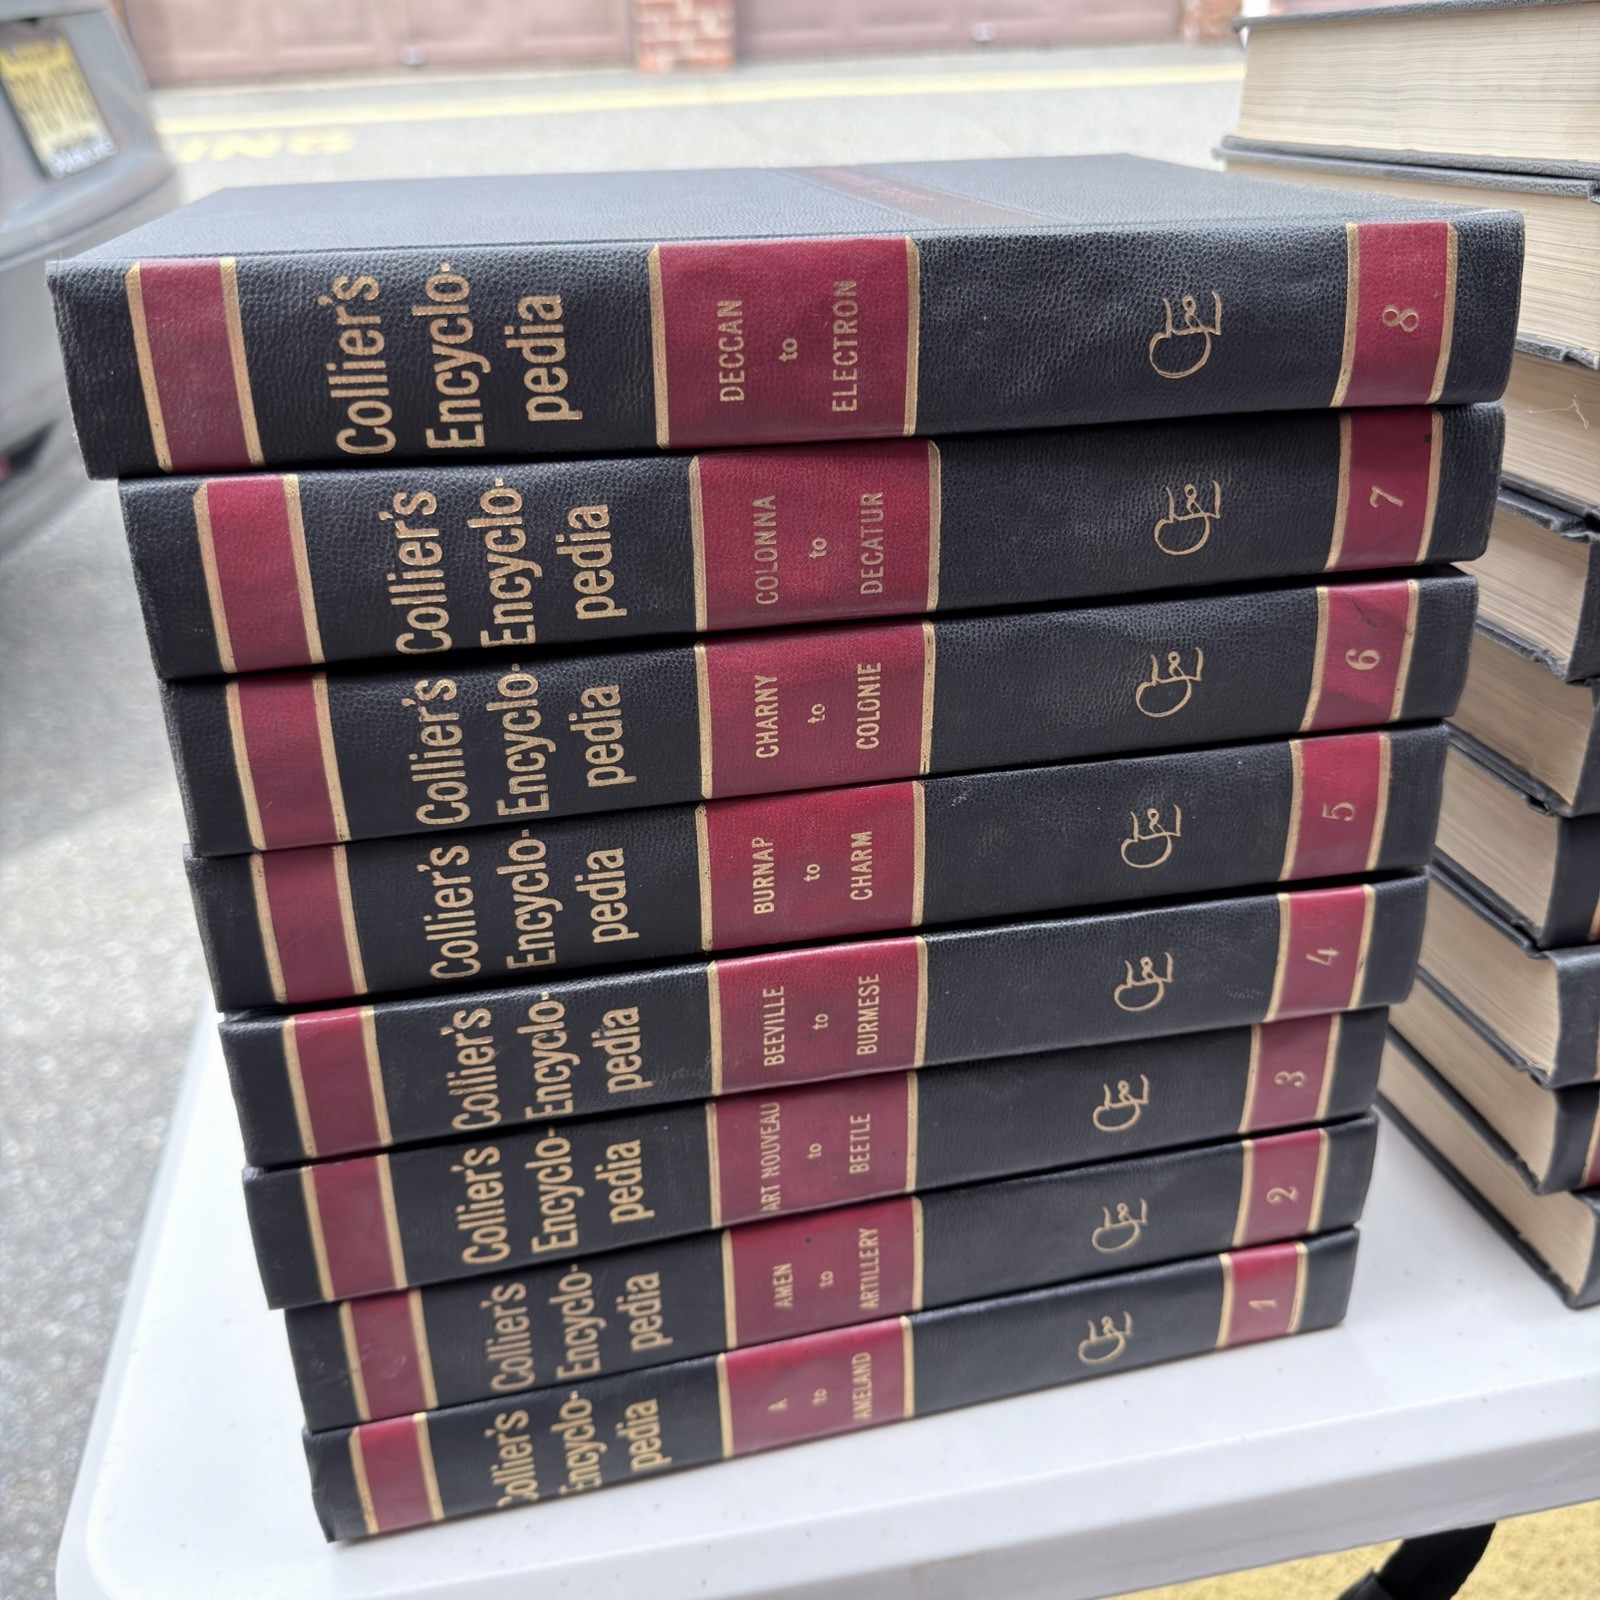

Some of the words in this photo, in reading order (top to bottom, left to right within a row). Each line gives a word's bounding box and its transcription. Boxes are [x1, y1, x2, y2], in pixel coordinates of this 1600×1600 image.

[504, 294, 584, 422] pedia
[717, 299, 746, 402] DECCAN
[778, 337, 799, 363] to
[831, 279, 858, 413] ELECTRON
[1381, 304, 1420, 333] 8
[318, 274, 397, 455] Collier's
[1369, 485, 1404, 508] 7
[378, 490, 453, 655] Collier's
[554, 503, 628, 620] pedia
[753, 494, 780, 605] COLONNA
[808, 537, 828, 560] to
[859, 491, 885, 595] DECATUR
[1344, 648, 1381, 672] 6
[568, 683, 638, 788] pedia
[753, 674, 780, 759] CHARNY
[807, 702, 827, 725] to
[855, 661, 882, 751] COLONIE
[401, 678, 472, 826] Collier's
[1321, 801, 1356, 823] 5
[573, 846, 640, 944] pedia
[751, 836, 776, 916] BURNAP
[803, 862, 822, 884] to
[849, 830, 874, 902] CHARM
[416, 844, 483, 981] Collier's
[1305, 946, 1340, 967] 4
[591, 1005, 654, 1094] pedia
[762, 985, 786, 1067] BEEVILLE
[811, 1013, 830, 1031] to
[856, 972, 881, 1056] BURMESE
[440, 1007, 502, 1132] Collier's
[1273, 1071, 1308, 1087] 3
[760, 1101, 781, 1180] NOUVEAU
[806, 1142, 823, 1160] to
[849, 1112, 871, 1175] BEETLE
[450, 1145, 511, 1264] Collier's
[594, 1138, 656, 1225] pedia
[760, 1190, 782, 1213] ART
[1265, 1186, 1298, 1205] 2
[772, 1262, 794, 1310] AMEN
[818, 1270, 835, 1289] to
[858, 1228, 880, 1310] ARTILLERY
[1248, 1297, 1278, 1310] 1
[480, 1281, 536, 1392] Collier's
[616, 1271, 675, 1352] pedia
[614, 1397, 673, 1472] pedia
[767, 1398, 789, 1413] A
[811, 1388, 828, 1407] to
